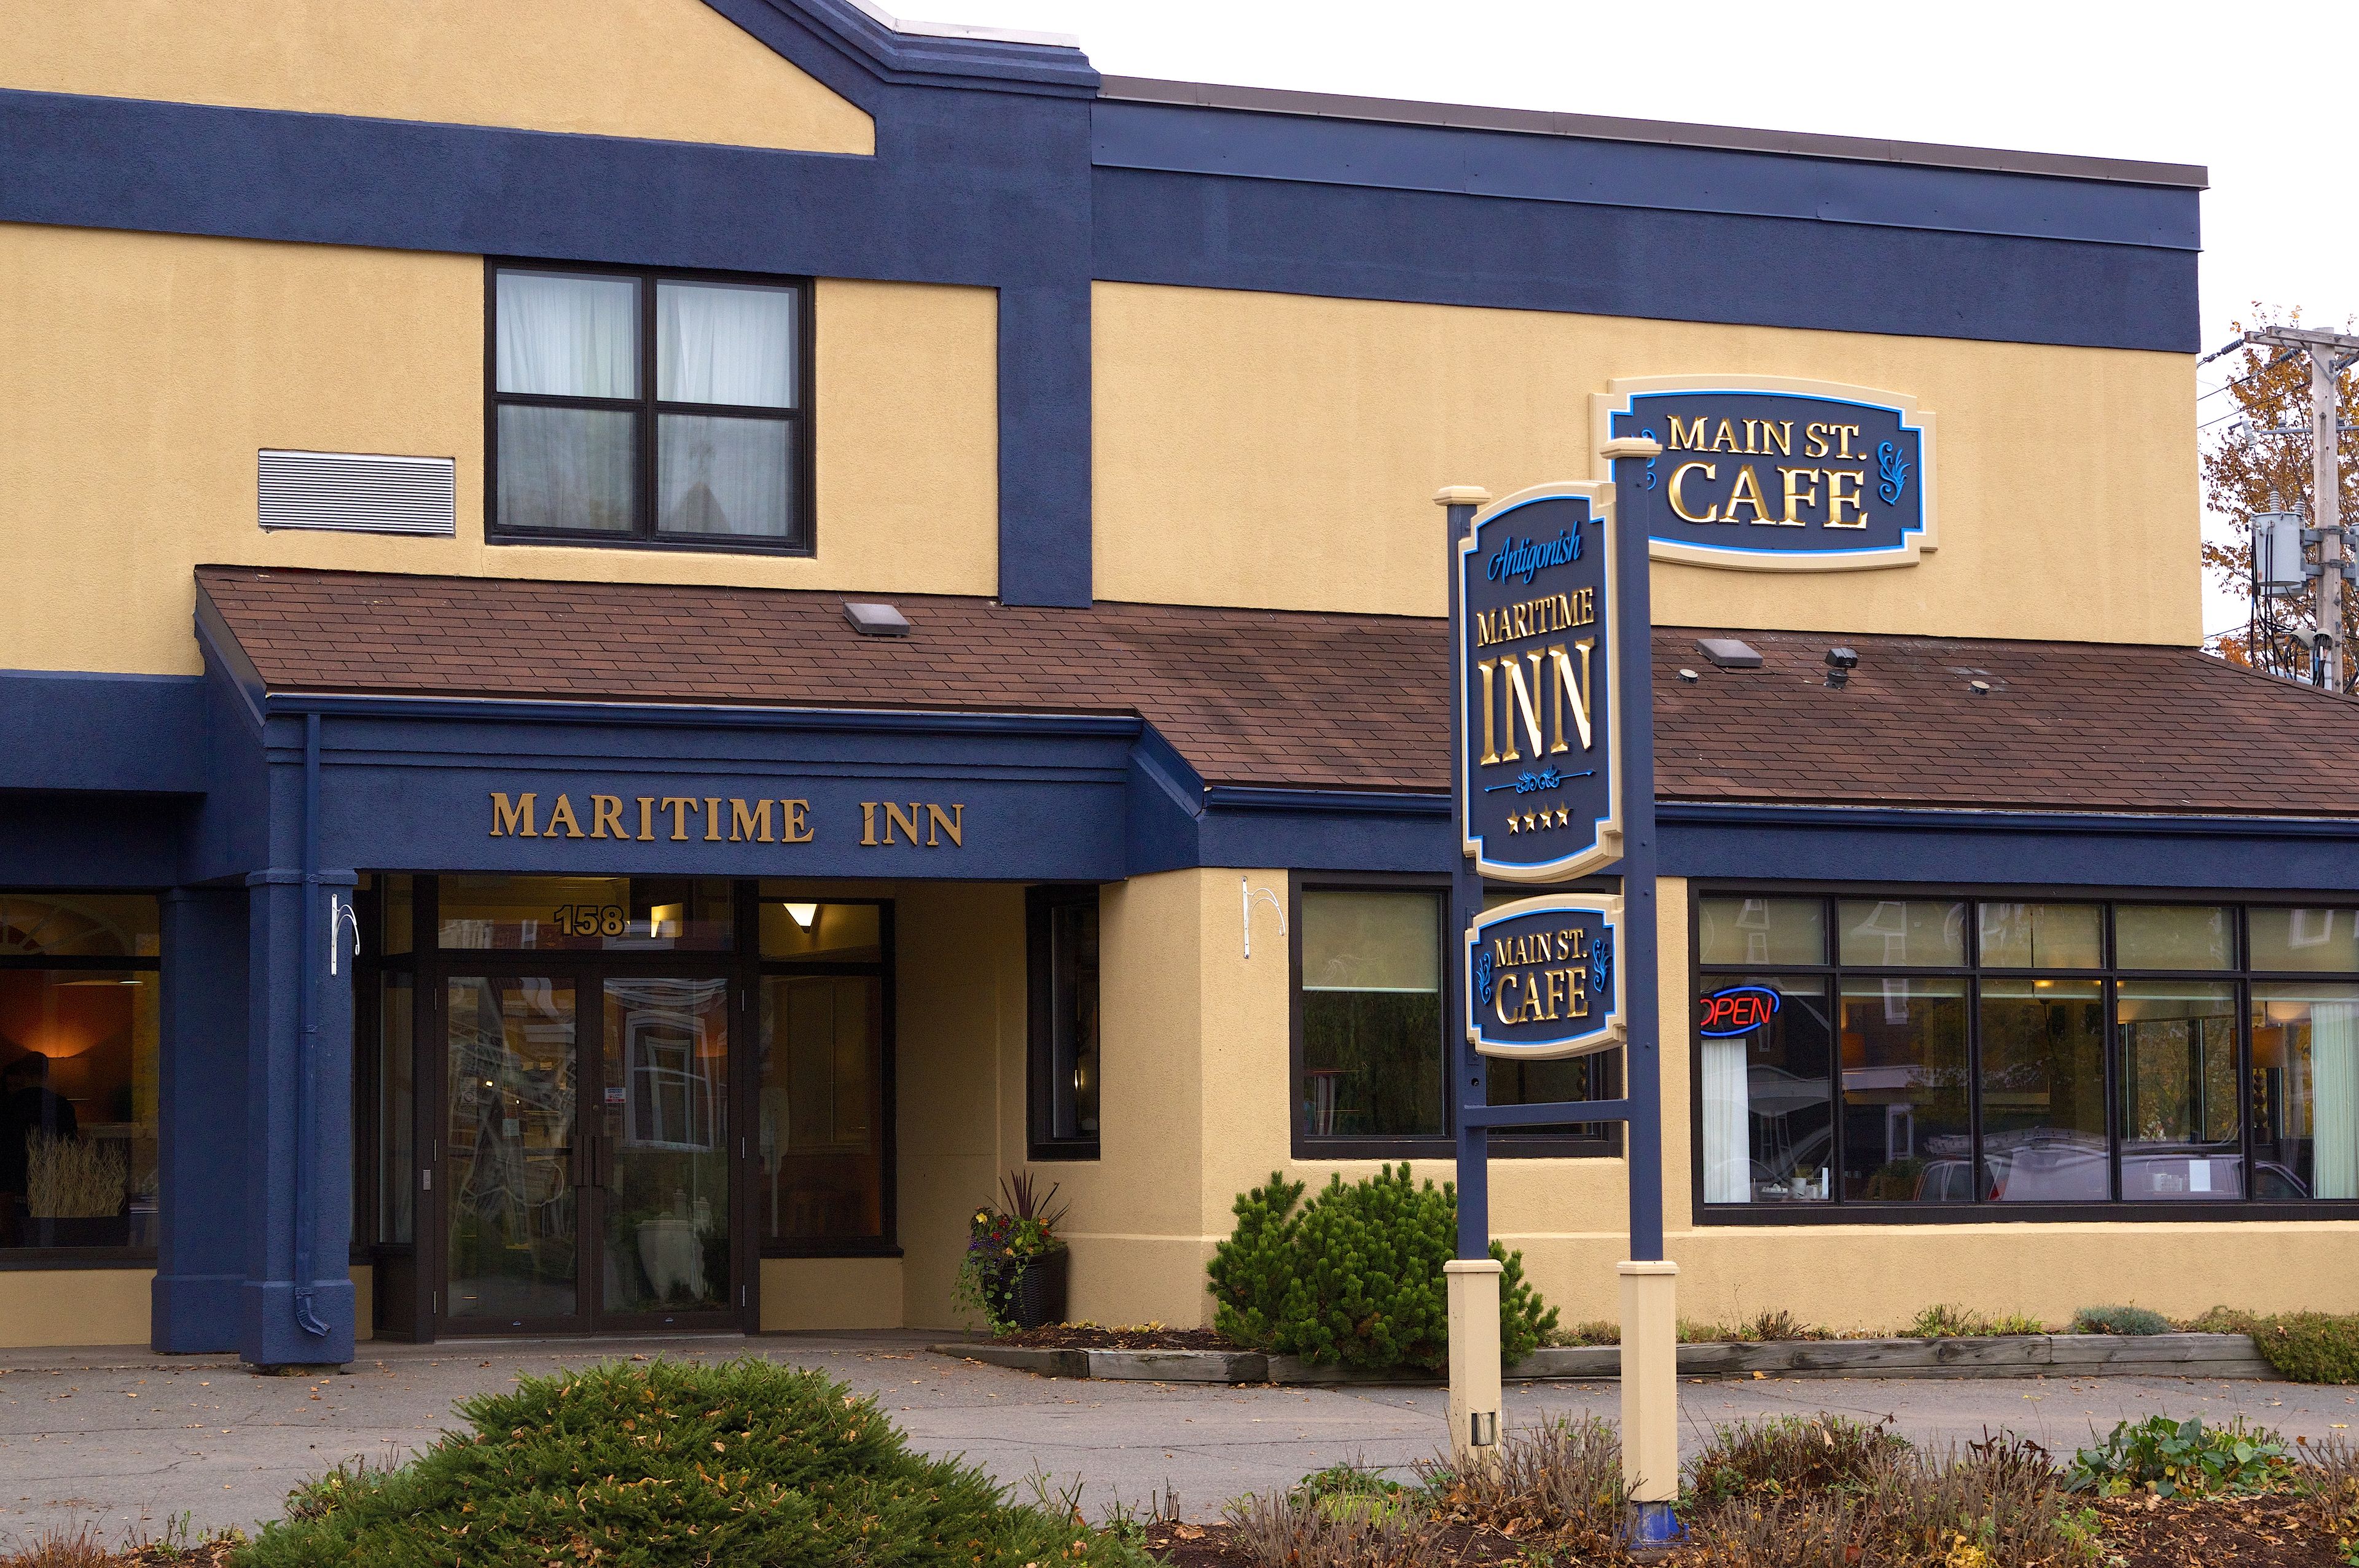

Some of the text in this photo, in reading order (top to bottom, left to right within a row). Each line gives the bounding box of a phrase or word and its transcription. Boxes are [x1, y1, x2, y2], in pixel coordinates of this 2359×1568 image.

[1666, 415, 1868, 461] MAIN ST.
[1667, 461, 1868, 529] CAFE
[1487, 521, 1581, 584] Antigonish
[1476, 586, 1595, 647] MARITIME
[1478, 636, 1595, 766] INN
[490, 792, 964, 847] MARITIME INN
[554, 904, 625, 937] 158
[1494, 928, 1588, 967] MAIN ST.
[1495, 965, 1589, 1024] CAFE
